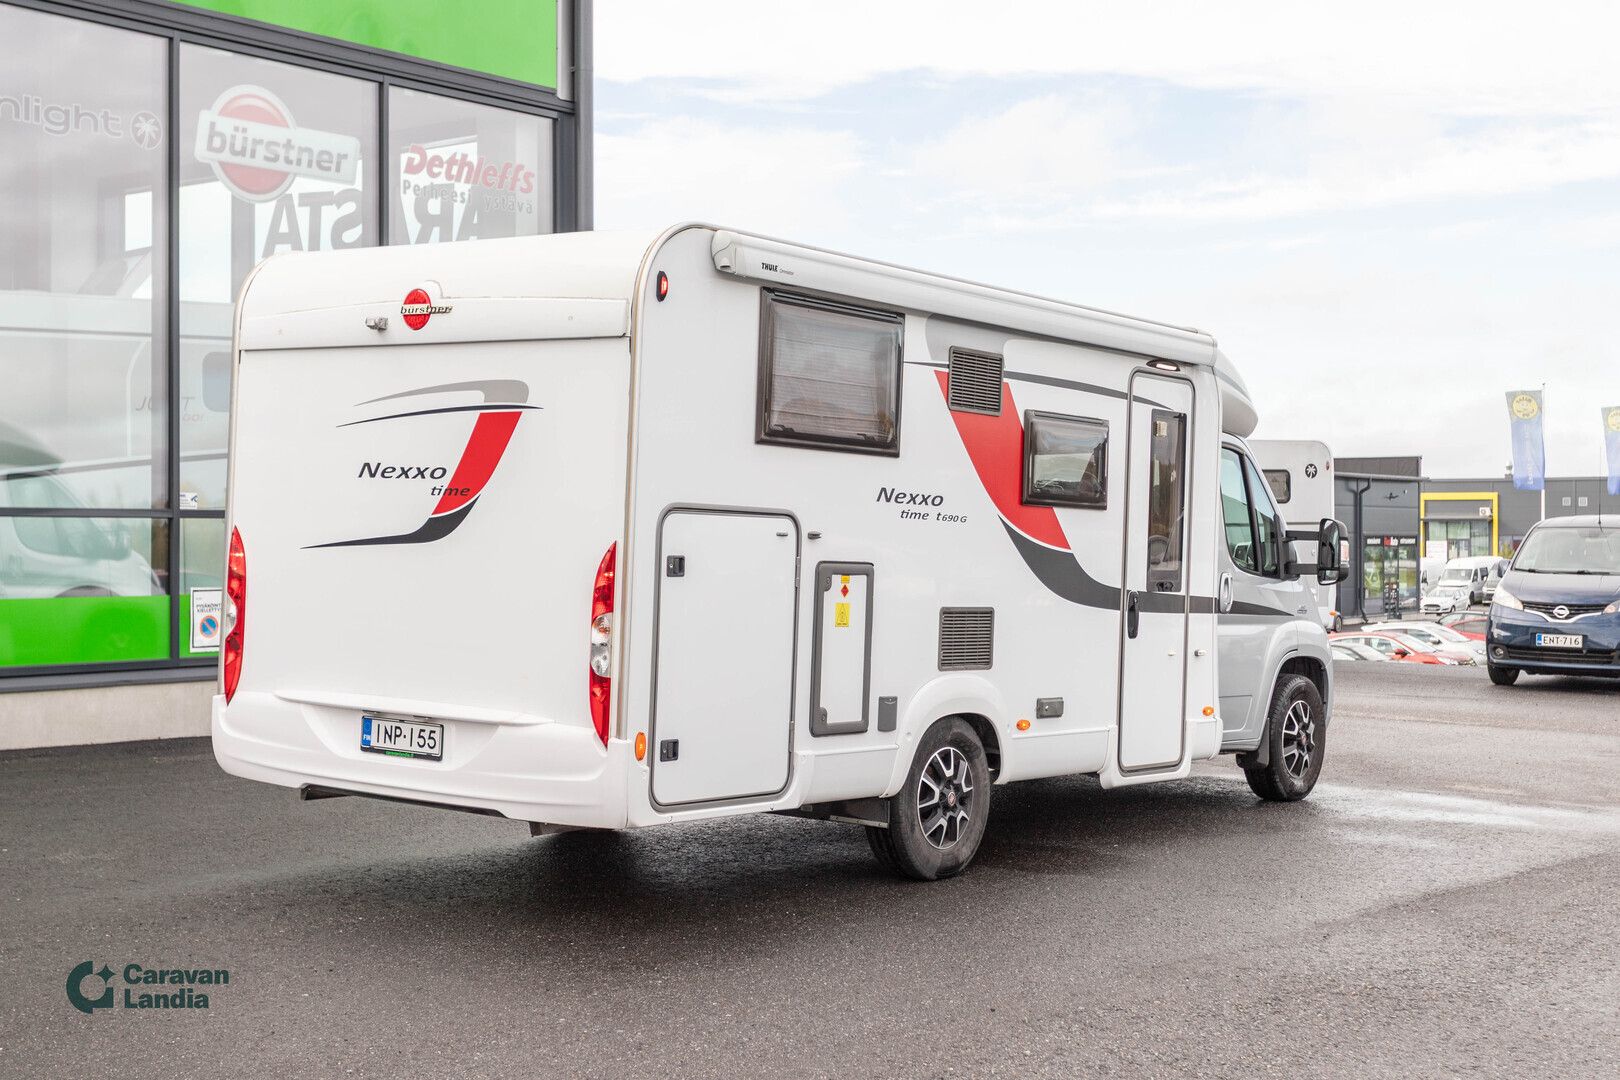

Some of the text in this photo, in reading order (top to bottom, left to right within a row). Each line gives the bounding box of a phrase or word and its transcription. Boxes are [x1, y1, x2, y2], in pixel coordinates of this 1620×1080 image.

[206, 121, 349, 174] bürstner
[403, 143, 536, 194] Dethleffs
[761, 262, 779, 273] THULE
[400, 305, 453, 315] bürstner
[358, 462, 447, 480] Nexxo
[430, 485, 471, 497] time
[876, 487, 944, 507] Nexxo
[900, 509, 930, 521] time
[1543, 636, 1580, 646] ENT-716
[376, 723, 437, 750] INP-155
